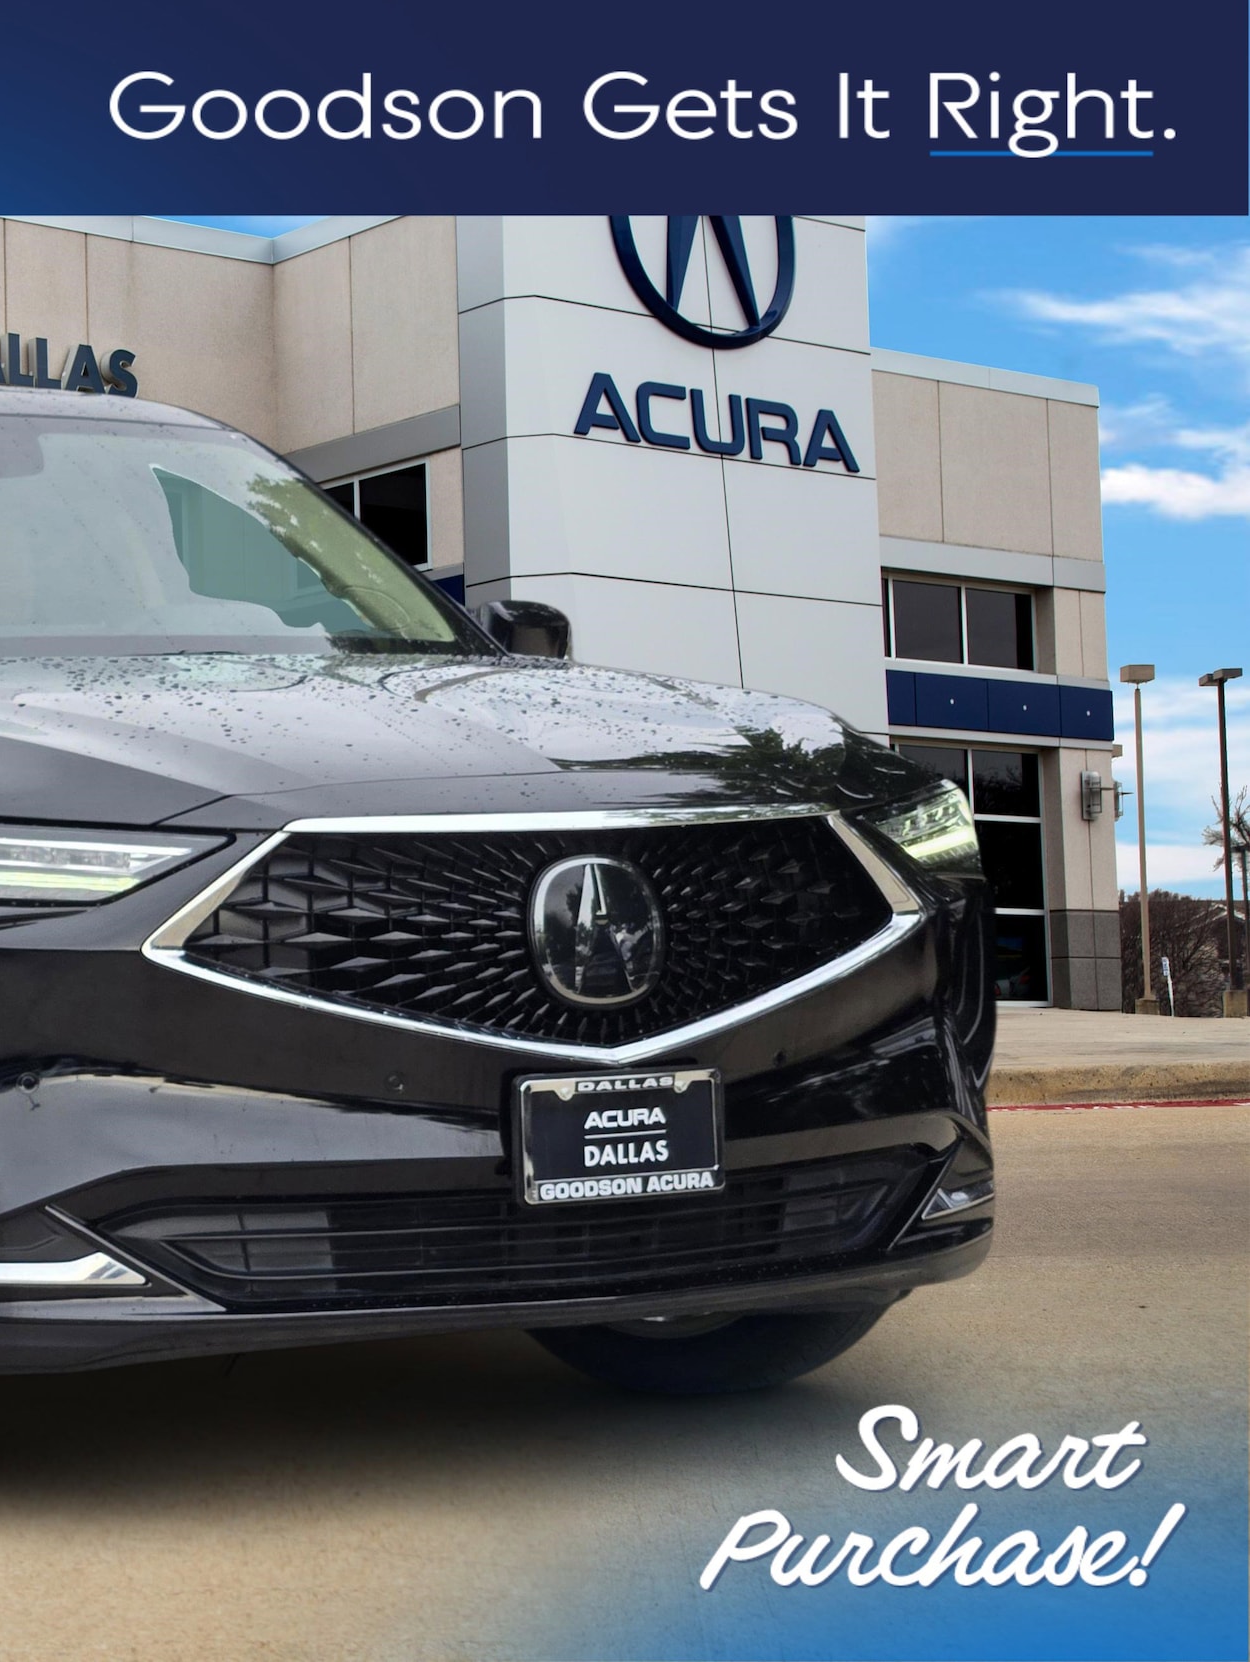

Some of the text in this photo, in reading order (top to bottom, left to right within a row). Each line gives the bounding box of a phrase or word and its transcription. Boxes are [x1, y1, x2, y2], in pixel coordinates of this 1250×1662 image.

[573, 371, 860, 473] ACURA
[578, 1077, 674, 1091] DALLAS
[584, 1107, 666, 1129] ACURA
[584, 1140, 668, 1167] DALLAS
[539, 1172, 714, 1201] GOODSON ACURA
